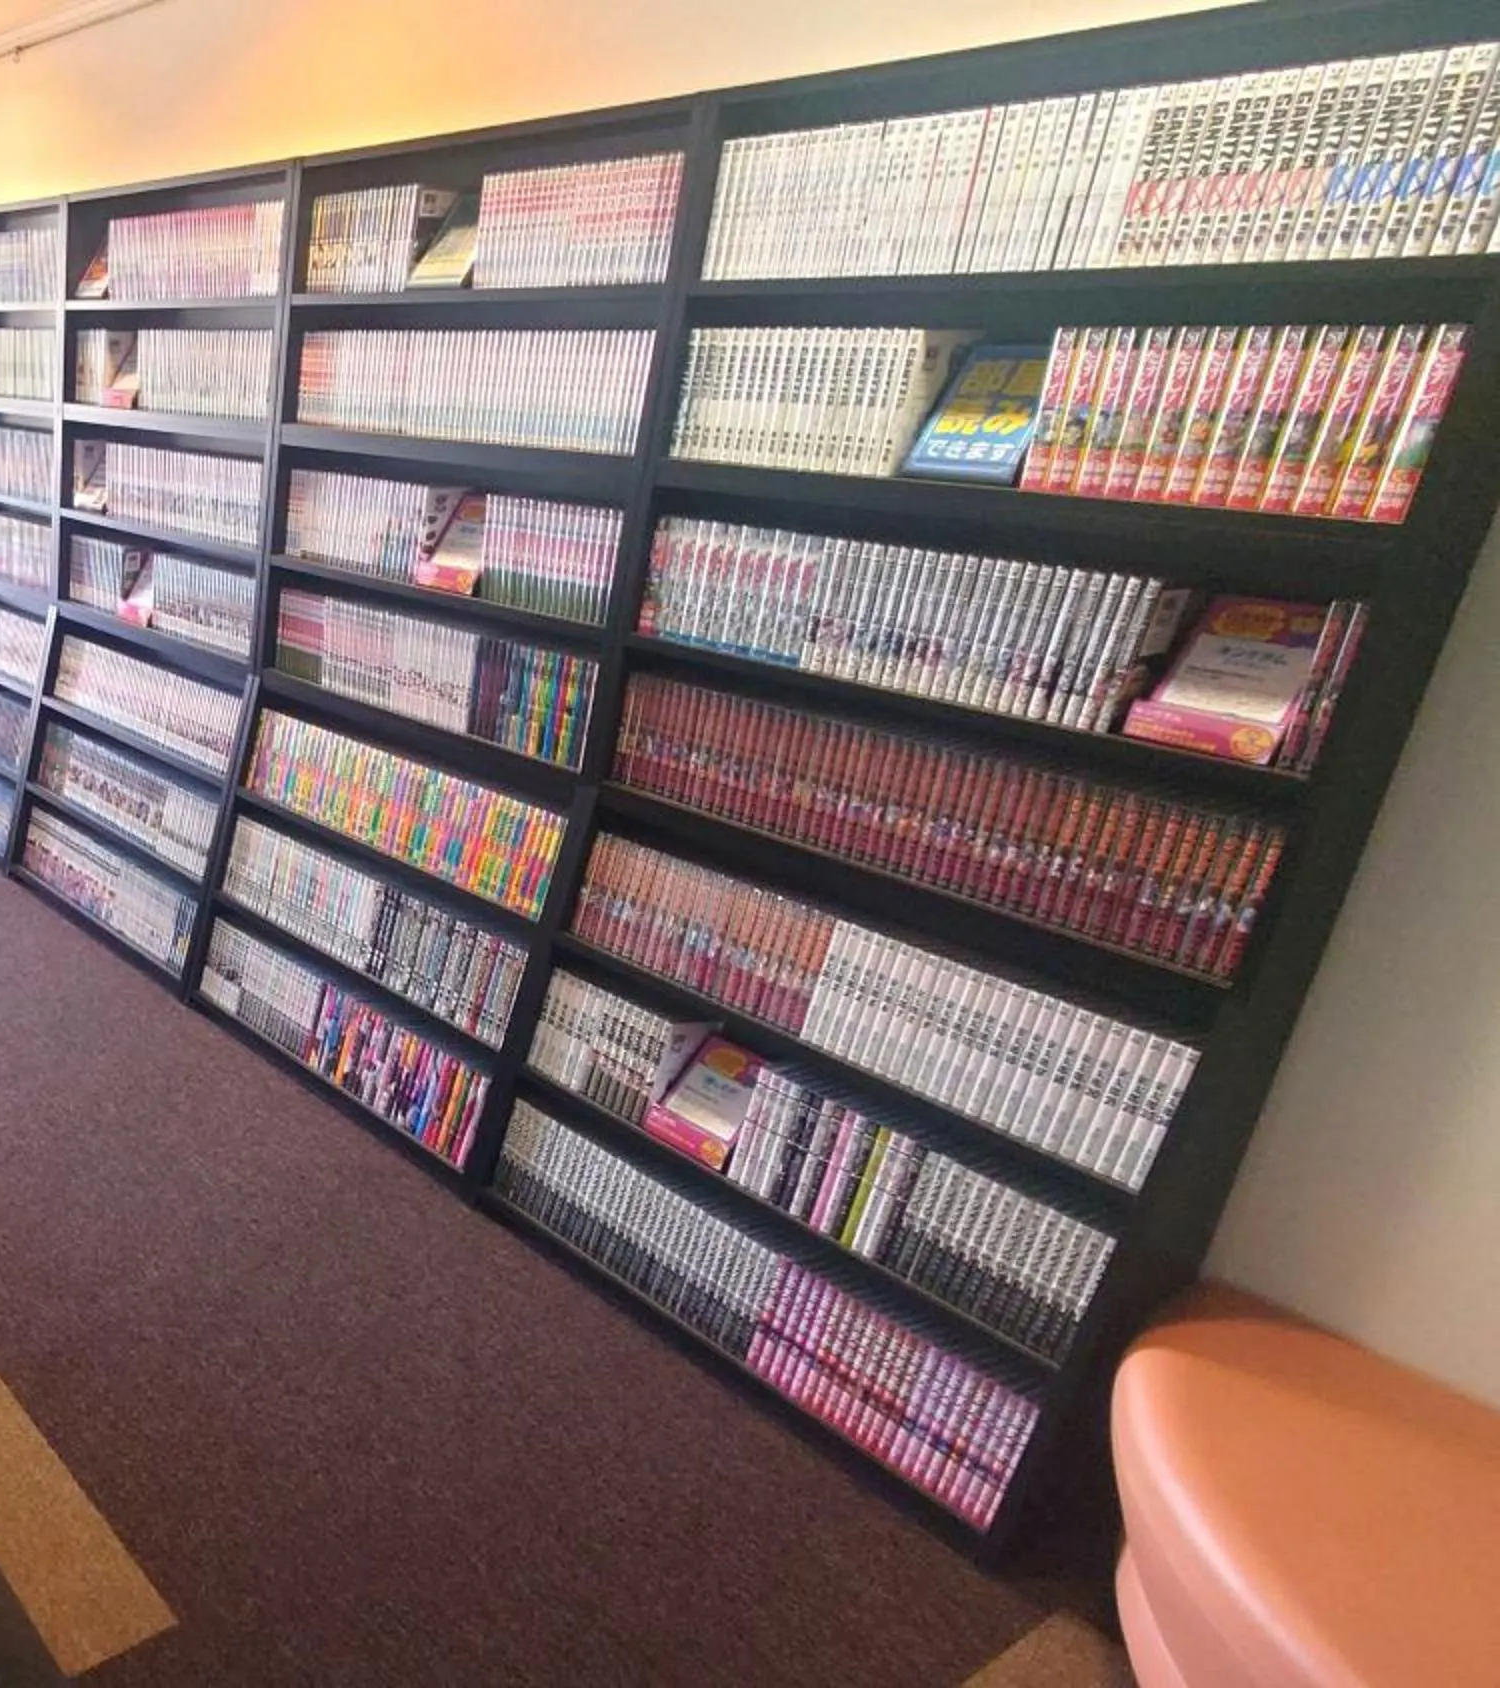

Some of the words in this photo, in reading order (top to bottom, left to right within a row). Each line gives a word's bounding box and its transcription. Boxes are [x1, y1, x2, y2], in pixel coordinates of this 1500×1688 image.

[1156, 105, 1188, 165] GANTZ
[1177, 104, 1208, 164] GANTZ
[1198, 100, 1229, 162] GANTZ
[1218, 97, 1251, 160] GANTZ
[1238, 96, 1269, 158] GANTZ
[1260, 93, 1293, 156] GANTZ
[1279, 91, 1315, 154] GANTZ
[1304, 88, 1338, 151] GANTZ
[1325, 85, 1360, 149] GANTZ
[1347, 83, 1383, 148] GANTZ
[1372, 80, 1408, 146] GANTZ
[1392, 77, 1431, 145] GANTZ
[1422, 73, 1461, 142] GANTZ
[1448, 69, 1485, 141] GANTZ
[1141, 108, 1170, 166] GANTZ
[927, 438, 1017, 462] できます
